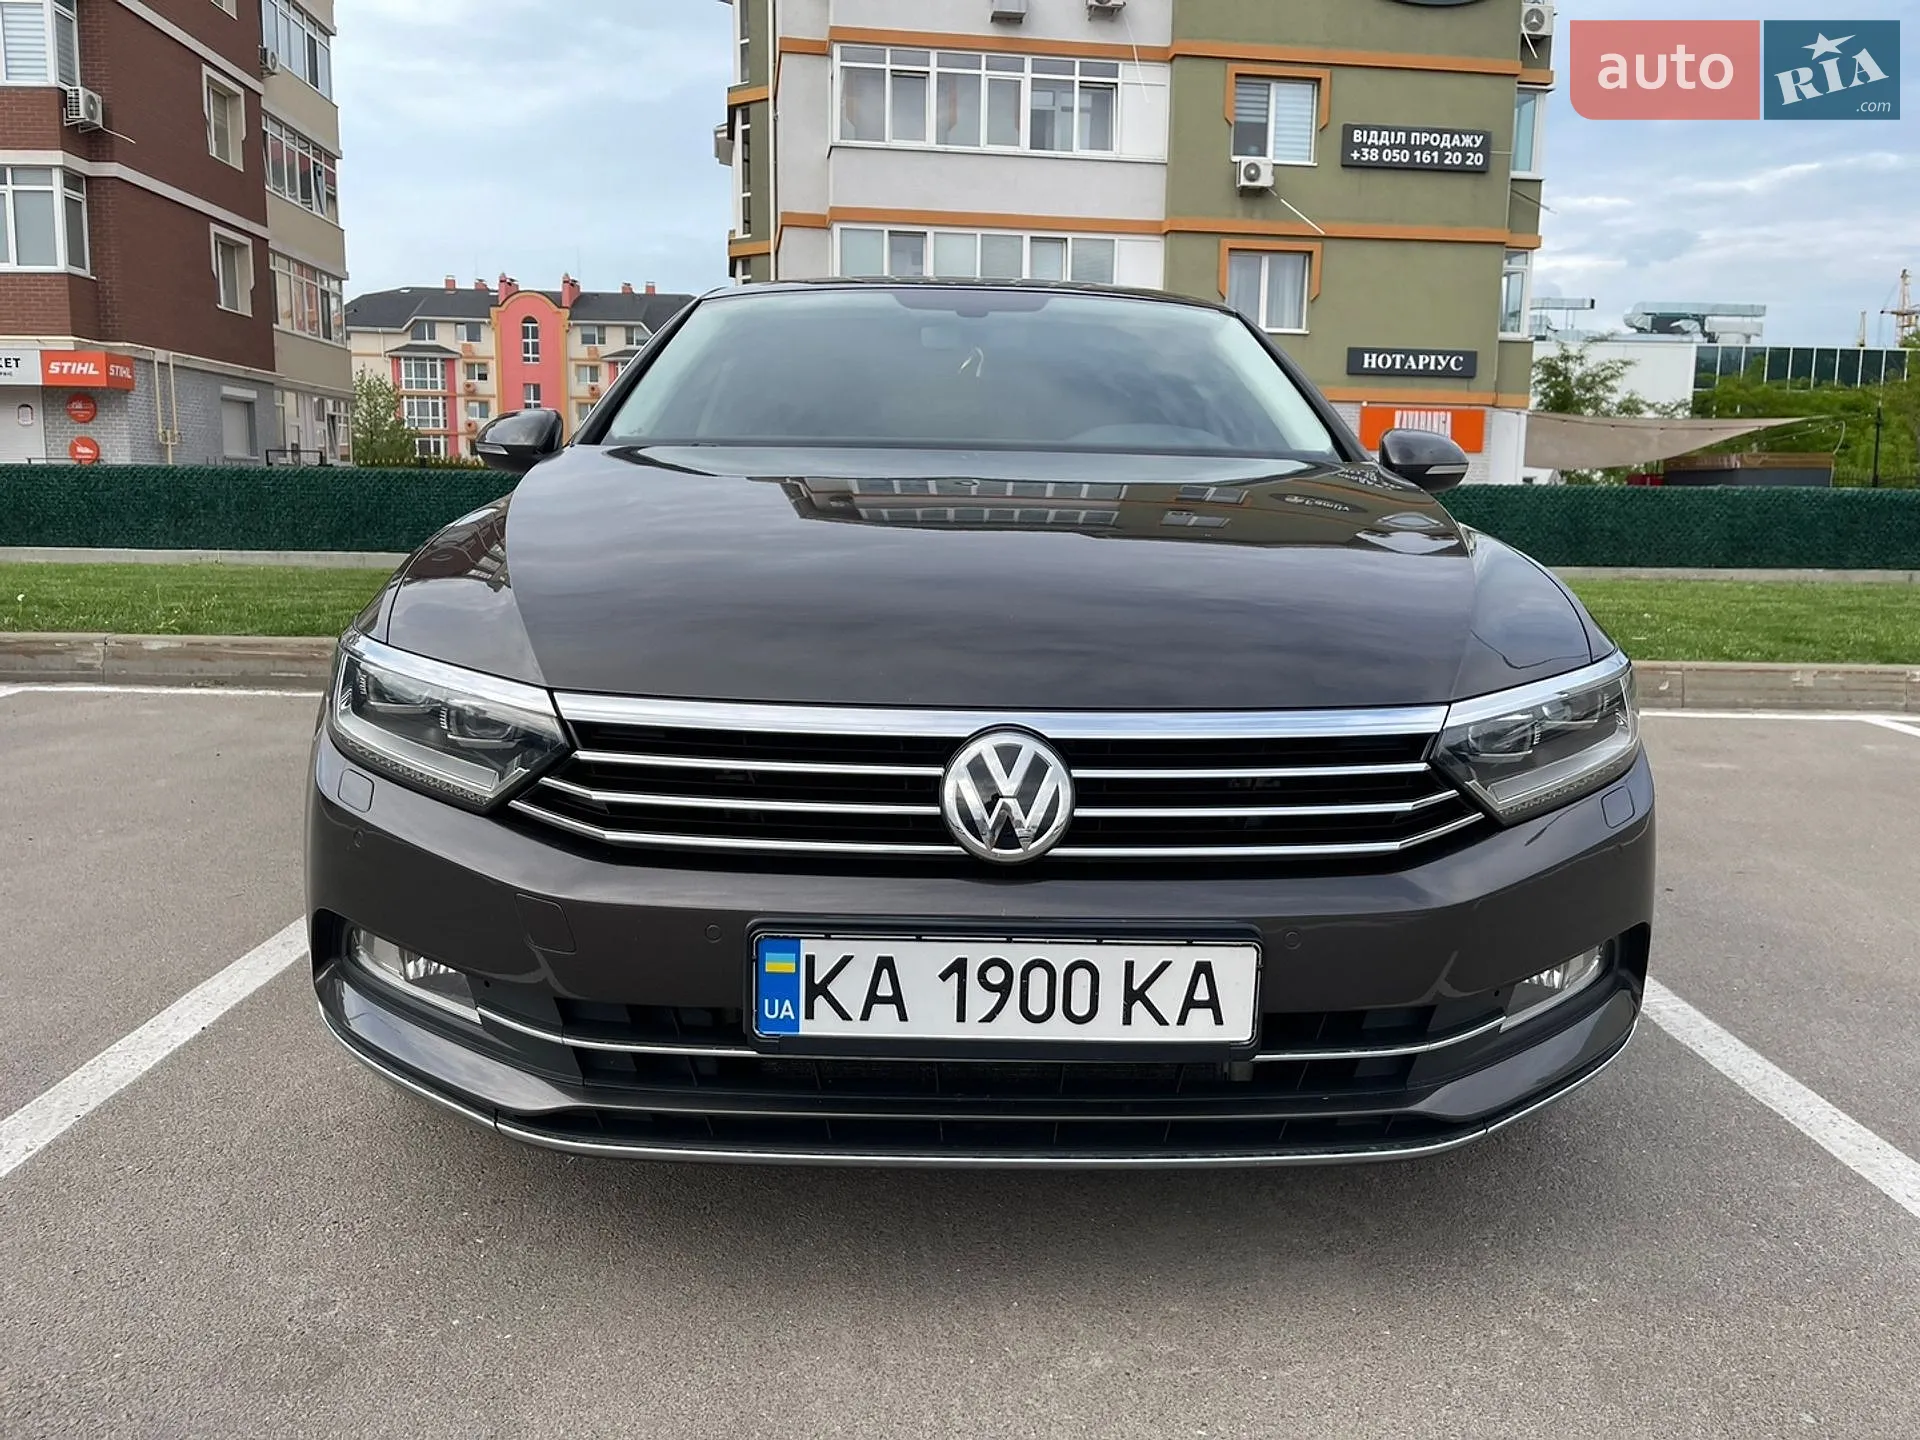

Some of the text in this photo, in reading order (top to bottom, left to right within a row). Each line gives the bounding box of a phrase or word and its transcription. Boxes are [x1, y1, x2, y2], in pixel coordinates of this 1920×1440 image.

[1353, 129, 1484, 149] ВІДДІЛ ПРОДАЖУ
[1350, 147, 1484, 166] +38 050 161 20 20
[48, 361, 100, 375] STIHL
[109, 364, 132, 379] STIHL
[1362, 353, 1464, 371] НОТАРІУС
[804, 953, 1225, 1027] KA 1900 KA
[764, 999, 795, 1020] UA
